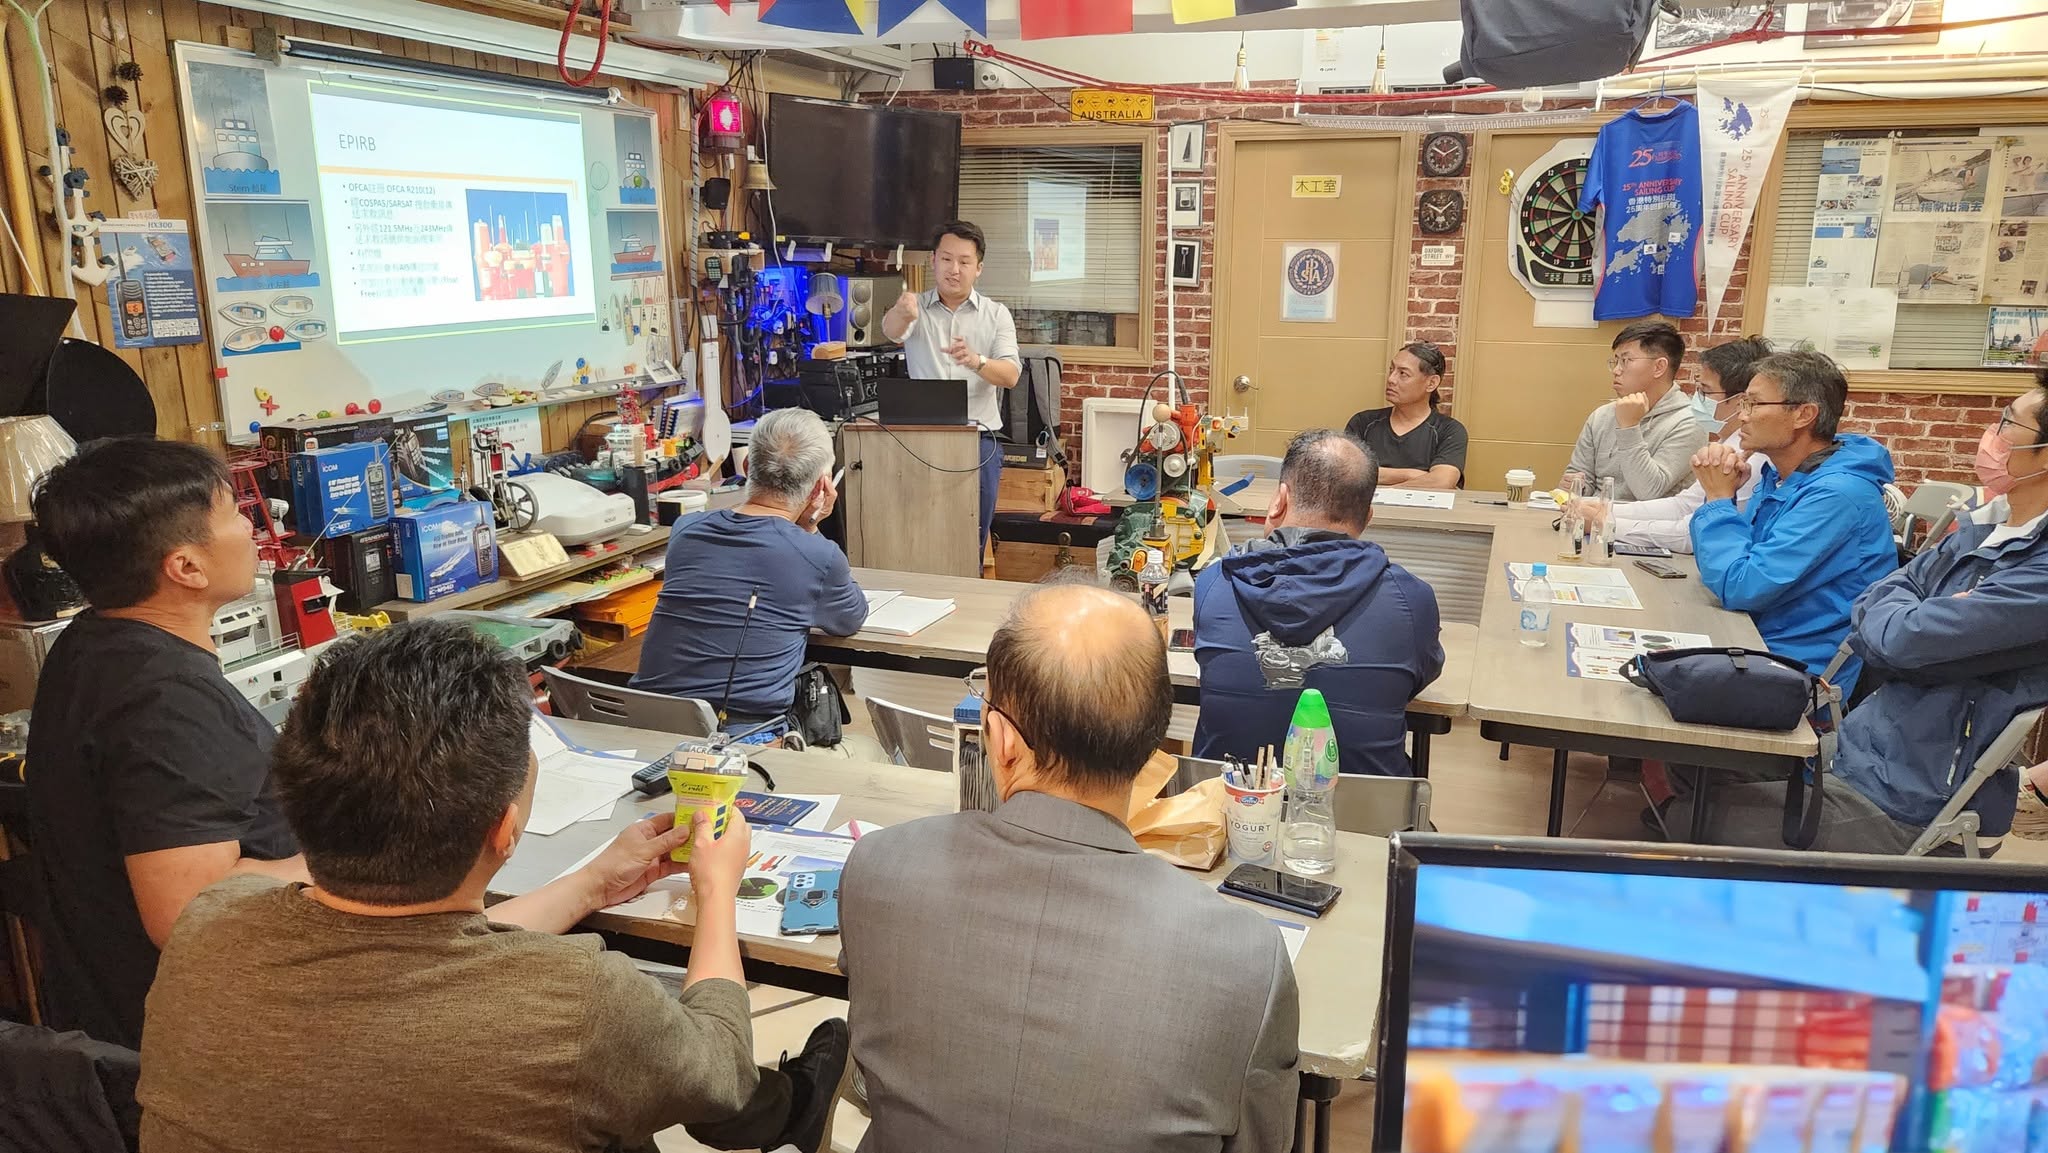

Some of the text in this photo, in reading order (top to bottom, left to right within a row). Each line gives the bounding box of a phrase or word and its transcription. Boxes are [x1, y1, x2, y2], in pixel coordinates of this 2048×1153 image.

[1080, 110, 1143, 119] AUSTRALIA
[339, 134, 376, 151] EPIRB
[1628, 148, 1654, 168] 25
[1296, 179, 1337, 193] 木工室
[1634, 186, 1662, 196] SAILING
[1719, 168, 1738, 235] SAILING CUP
[1728, 174, 1748, 249] ANNIVERSARY
[690, 746, 708, 754] ACR
[1231, 820, 1270, 832] YOGURT
